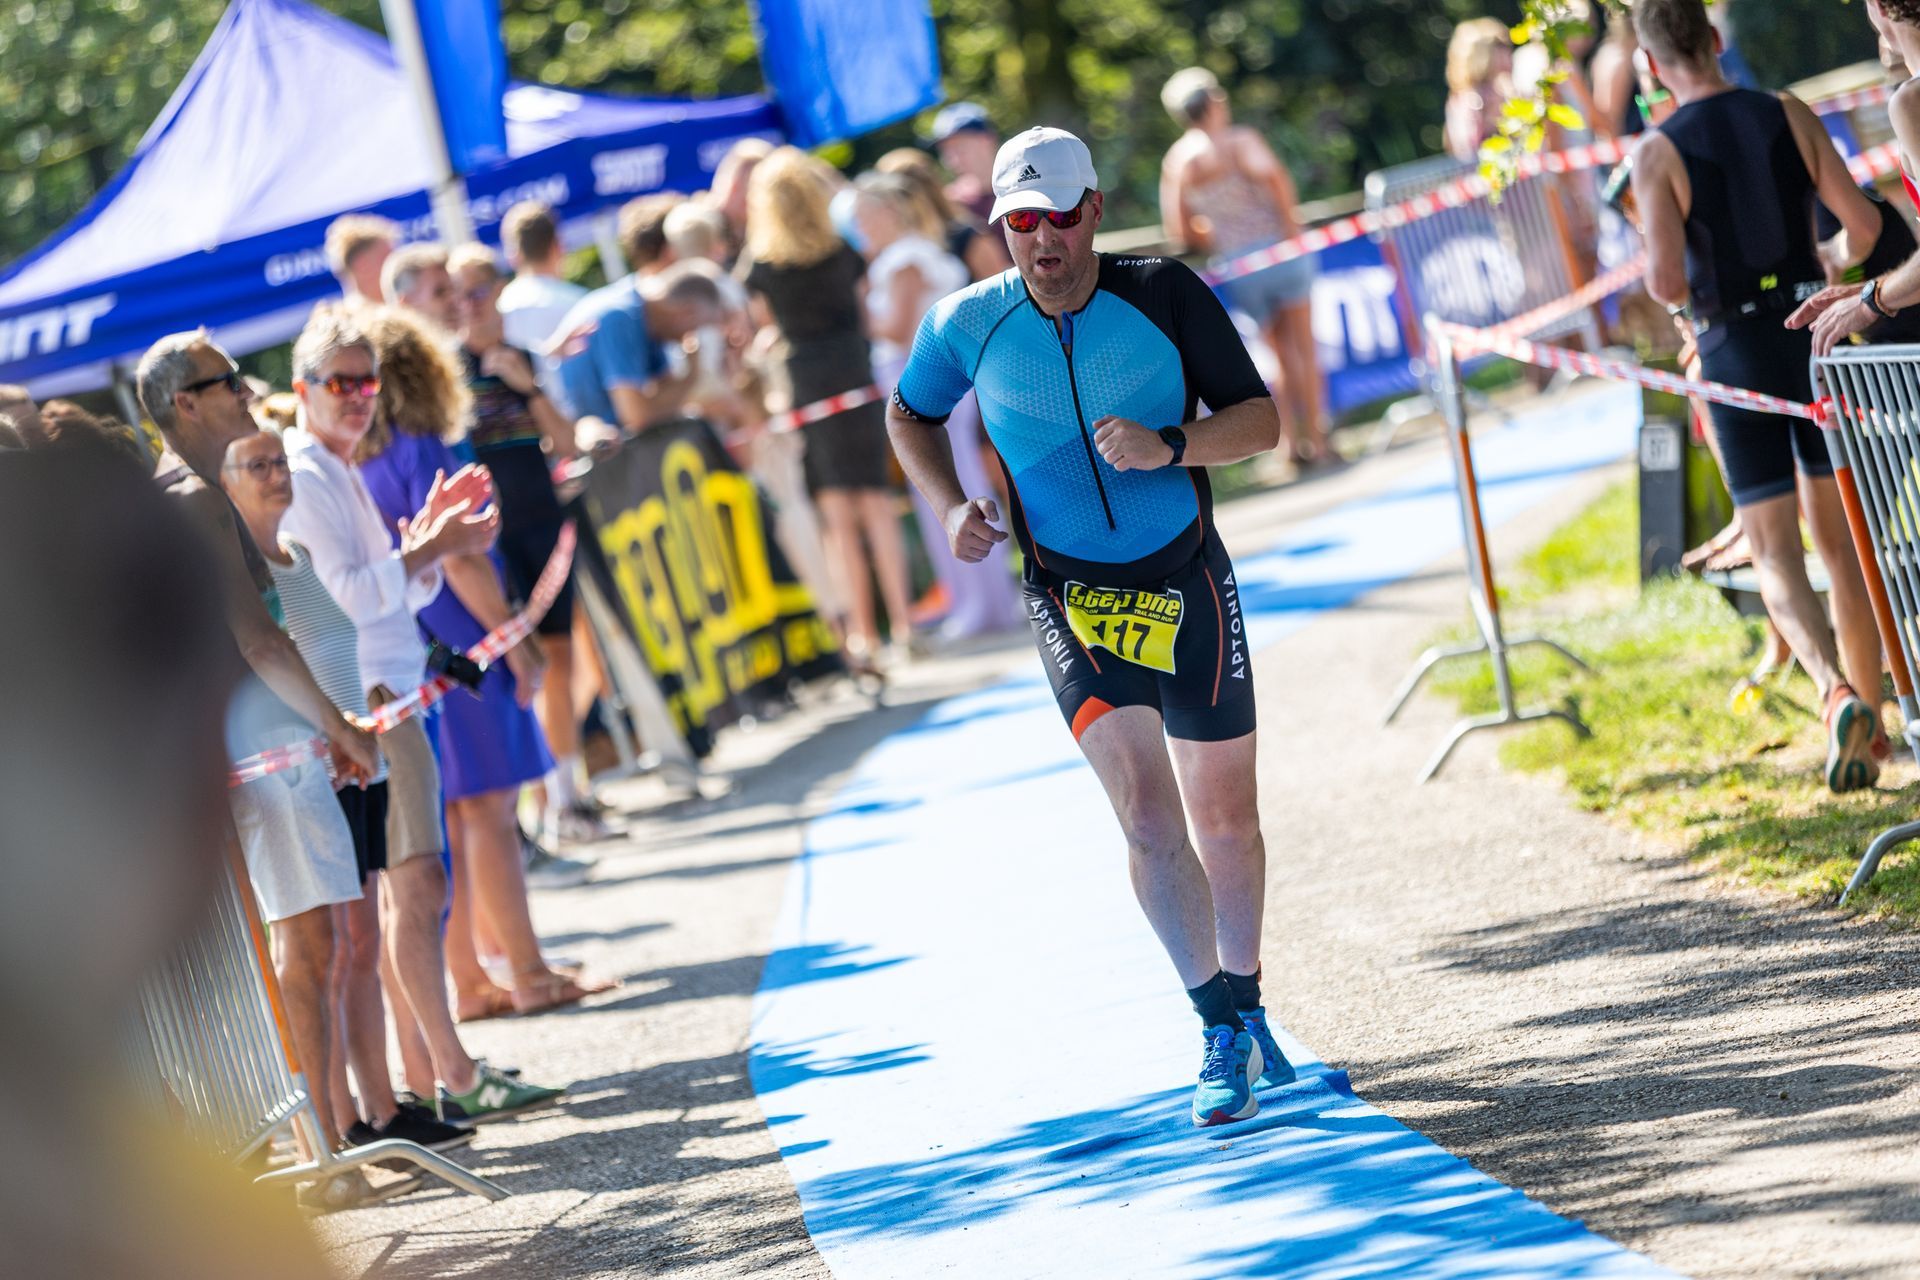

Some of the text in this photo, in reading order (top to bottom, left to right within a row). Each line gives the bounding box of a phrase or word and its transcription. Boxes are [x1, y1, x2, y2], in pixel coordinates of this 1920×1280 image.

[1017, 173, 1042, 183] adidas
[1116, 257, 1162, 266] APTONIA
[1068, 585, 1132, 614] Step
[1135, 591, 1181, 617] One
[1133, 608, 1175, 624] TRAIL AND RUN
[1029, 600, 1075, 675] APTONIA
[1092, 619, 1151, 661] 117
[1223, 571, 1245, 679] APTONIA
